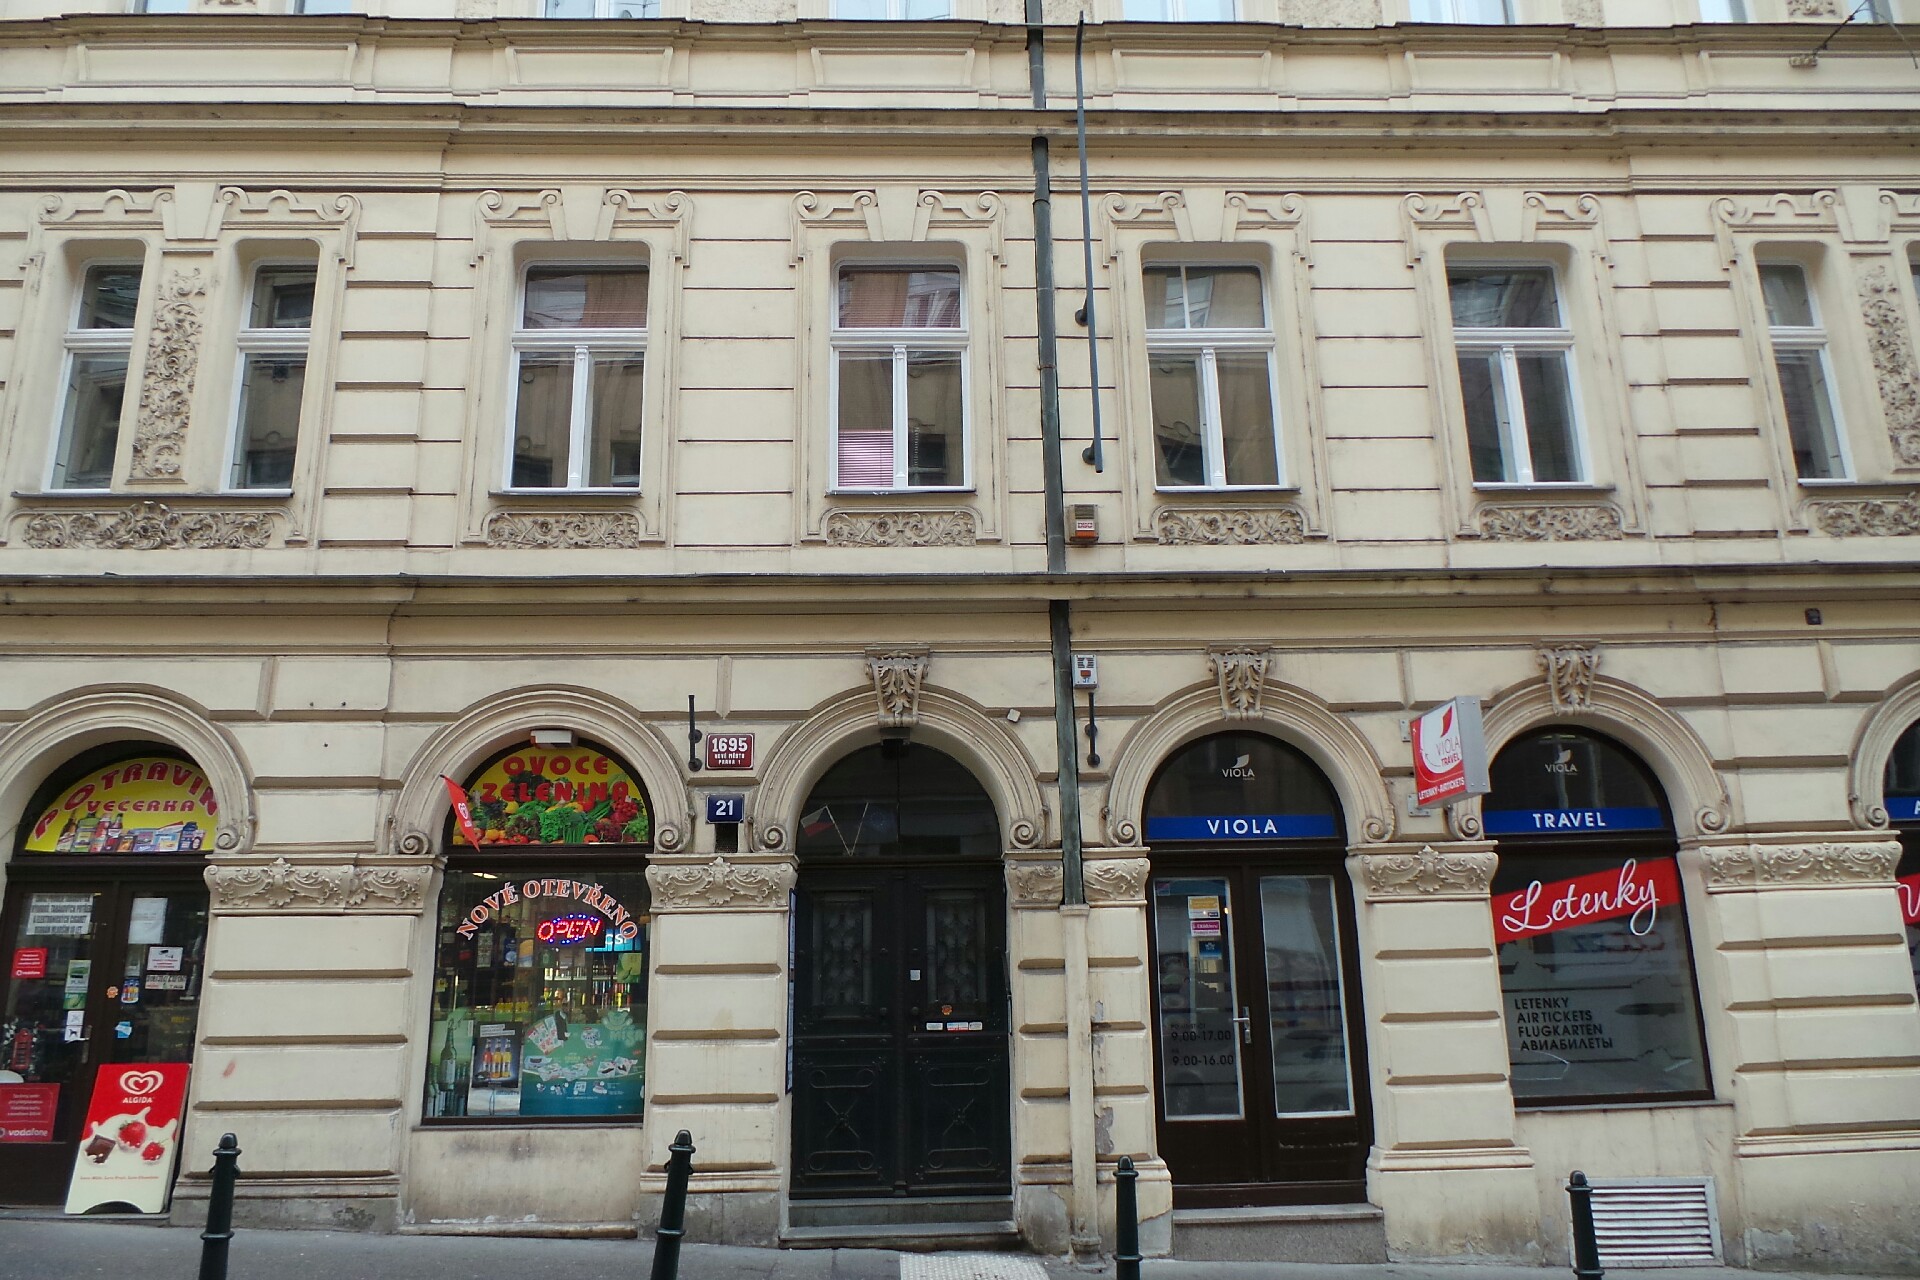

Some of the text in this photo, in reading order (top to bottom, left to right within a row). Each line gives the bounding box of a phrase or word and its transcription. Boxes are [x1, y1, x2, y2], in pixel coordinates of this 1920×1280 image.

[711, 737, 748, 752] 1695
[1436, 735, 1460, 756] VIOLA
[502, 755, 609, 776] OVOCE
[1441, 753, 1460, 767] TRAVEL
[1221, 768, 1256, 778] VIOLA
[1544, 763, 1578, 773] VIOLA
[480, 781, 629, 803] ZELENINA
[87, 797, 195, 812] VEČERKA
[715, 799, 734, 816] 21
[1206, 819, 1278, 834] VIOLA
[1532, 812, 1607, 828] TRAVEL
[1502, 858, 1660, 935] Letenky
[456, 878, 638, 940] NOVÉ OTEVŘENO
[537, 920, 601, 940] OPEN
[1514, 997, 1569, 1010] LETENKY
[1518, 1024, 1603, 1037] FLUGKARTEN
[1520, 1037, 1613, 1051] АВИАБИЛЕТЫ
[8, 1127, 48, 1137] vodafone
